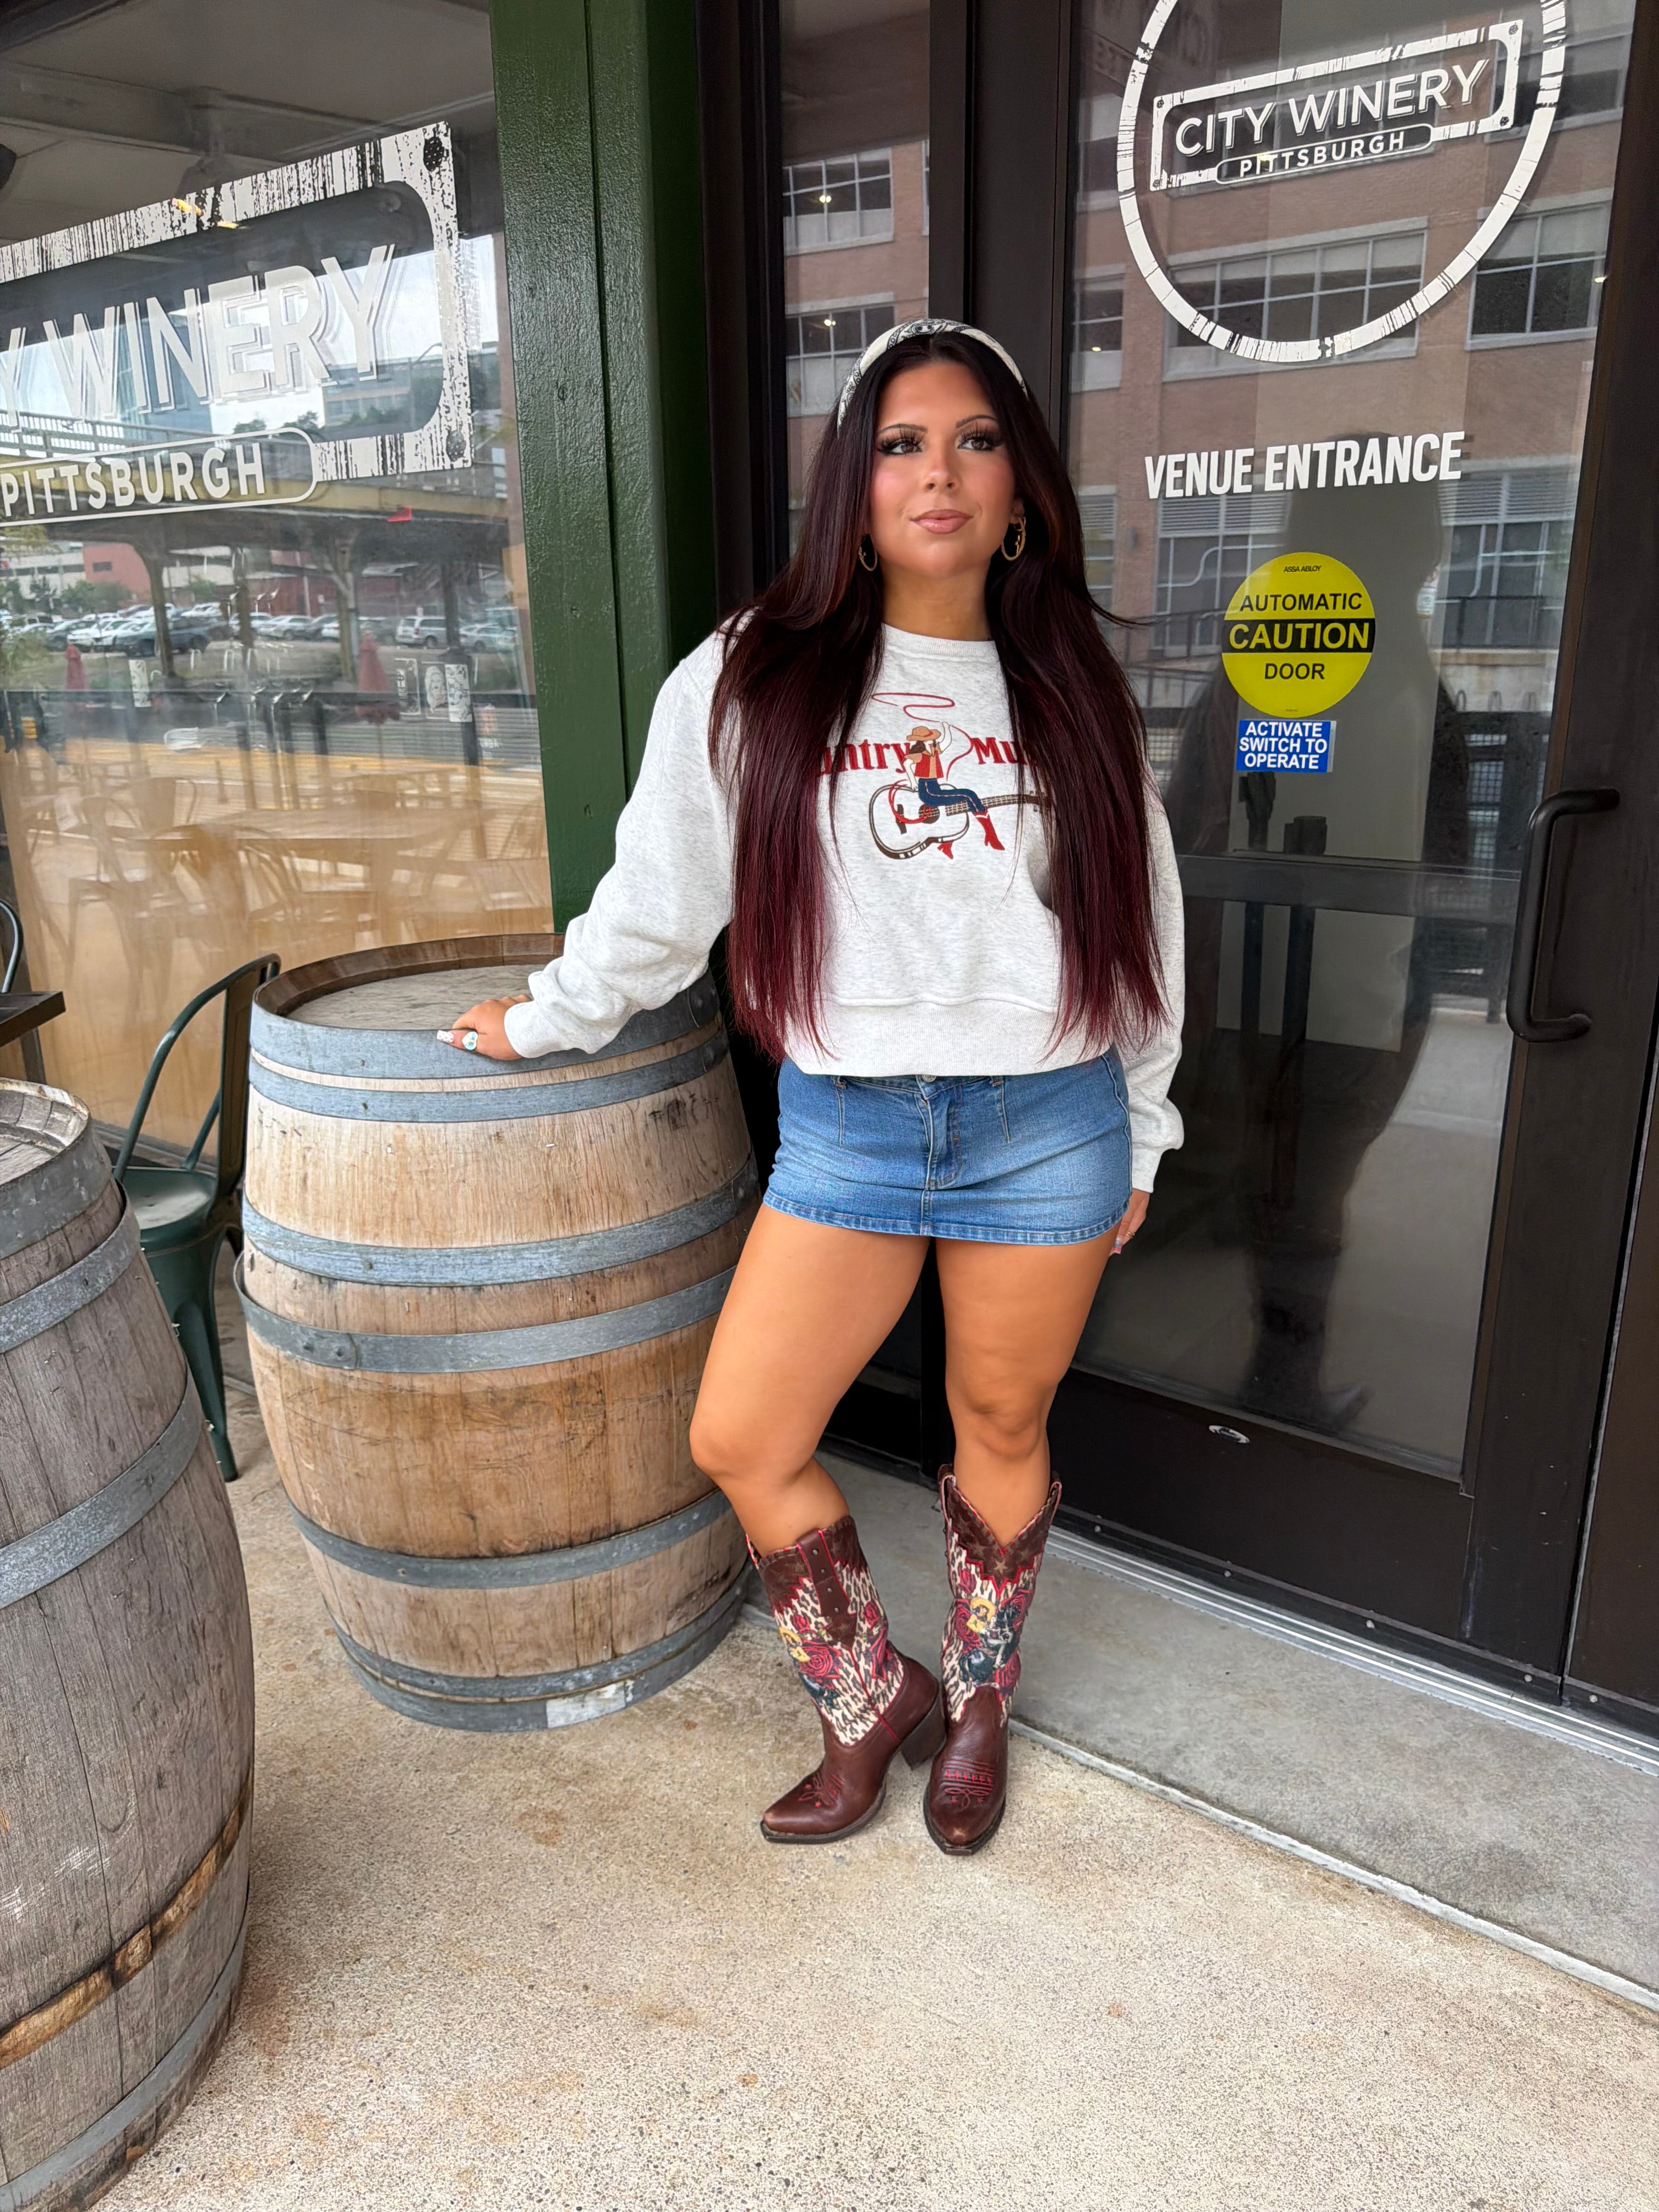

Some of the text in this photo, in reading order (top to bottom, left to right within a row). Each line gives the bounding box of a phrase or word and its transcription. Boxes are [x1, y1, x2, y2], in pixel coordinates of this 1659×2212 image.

[1176, 59, 1489, 157] CITY WINERY
[1239, 131, 1405, 178] PITTSBURGH
[43, 244, 395, 424] WINERY
[1145, 431, 1465, 499] VENUE ENTRANCE
[0, 443, 266, 517] PITTSBURGH
[1239, 592, 1362, 612] AUTOMATIC
[1229, 622, 1369, 650] CAUTION
[1265, 663, 1325, 680] DOOR
[1245, 721, 1323, 737] ACTIVATE
[1239, 737, 1328, 754] SWITCH TO
[1244, 753, 1319, 769] OPERATE
